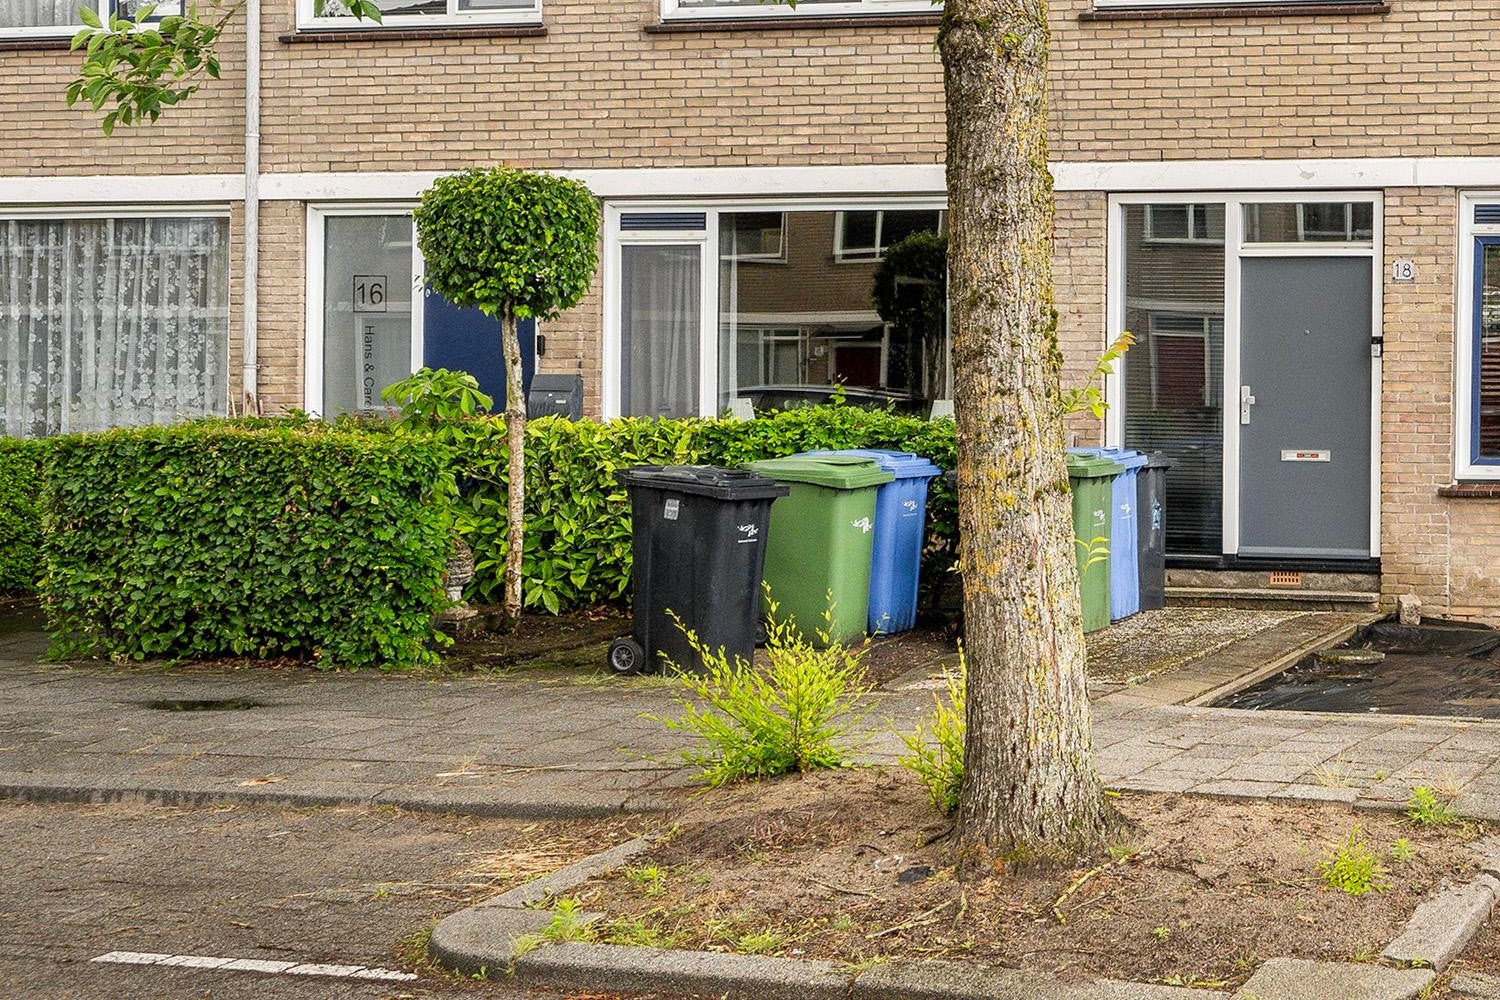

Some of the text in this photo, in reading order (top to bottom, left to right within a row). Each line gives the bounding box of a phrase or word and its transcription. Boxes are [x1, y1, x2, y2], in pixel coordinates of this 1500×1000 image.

[1395, 263, 1412, 278] 18
[356, 283, 383, 305] 16
[364, 325, 375, 359] Hans
[364, 364, 375, 372] &
